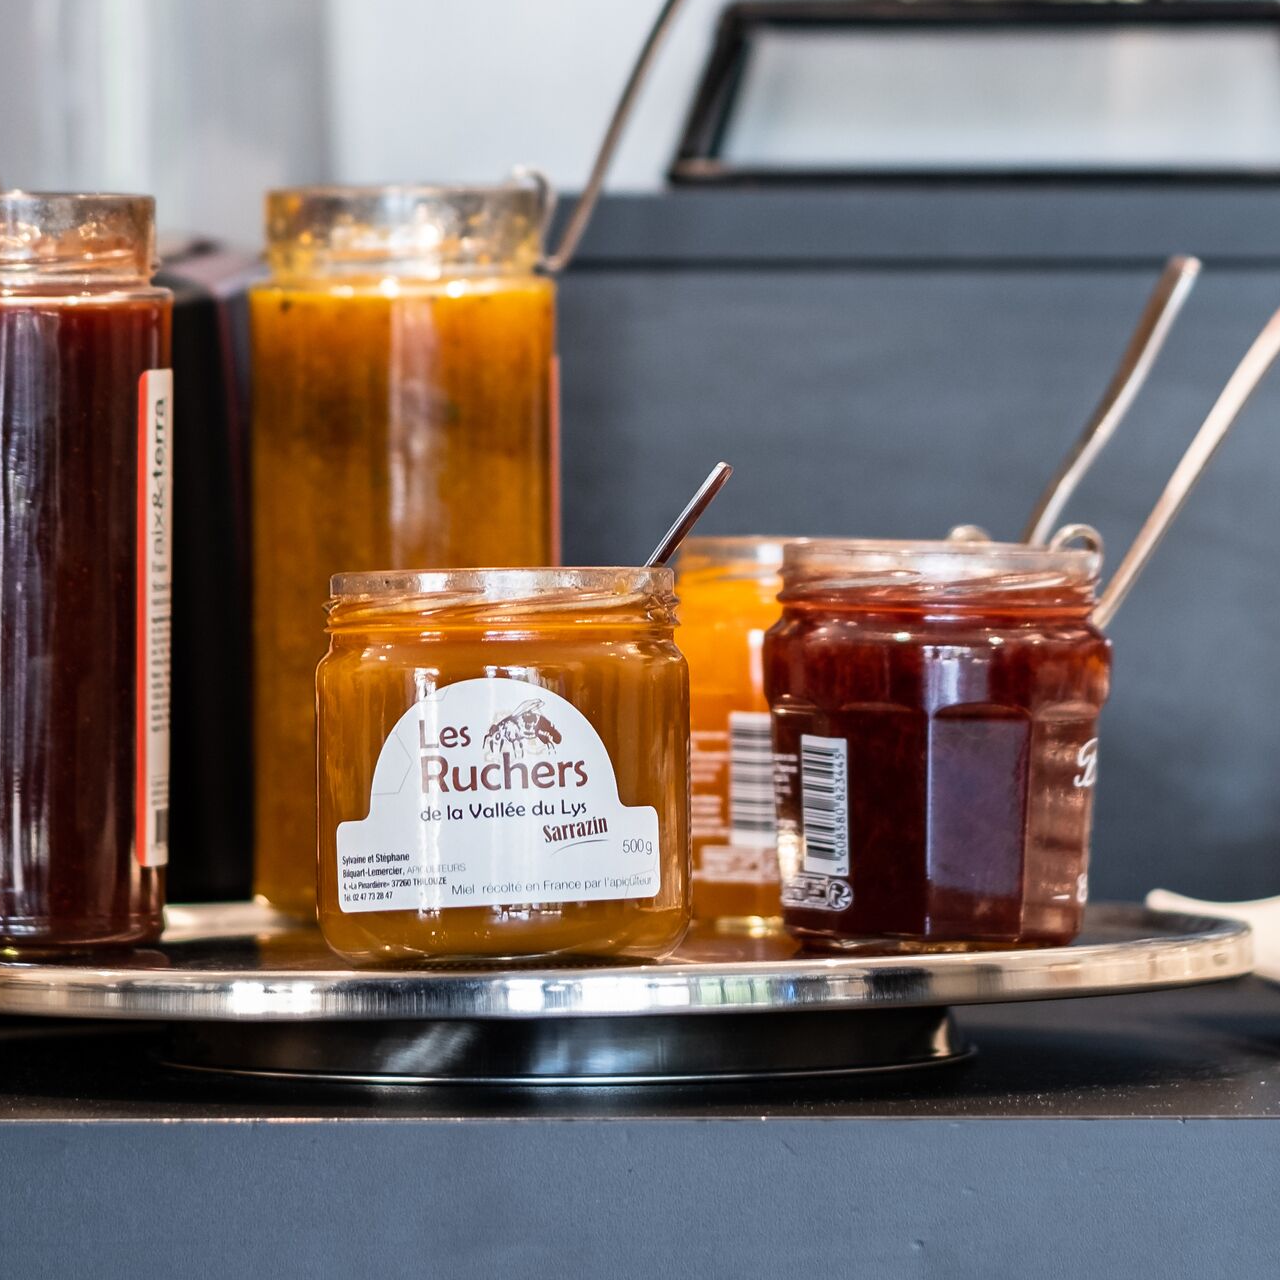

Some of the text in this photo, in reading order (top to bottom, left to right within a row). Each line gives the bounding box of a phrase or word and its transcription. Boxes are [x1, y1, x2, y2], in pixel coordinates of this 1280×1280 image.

[419, 719, 471, 748] Les
[420, 752, 588, 794] Ruchers
[834, 753, 846, 801] 823445
[420, 799, 587, 821] de la Vallée du Lys
[542, 816, 609, 843] Sarrazin
[367, 854, 375, 864] et
[375, 852, 410, 865] Stéphane
[452, 875, 652, 895] Miel récolté en France par l'apiculteur
